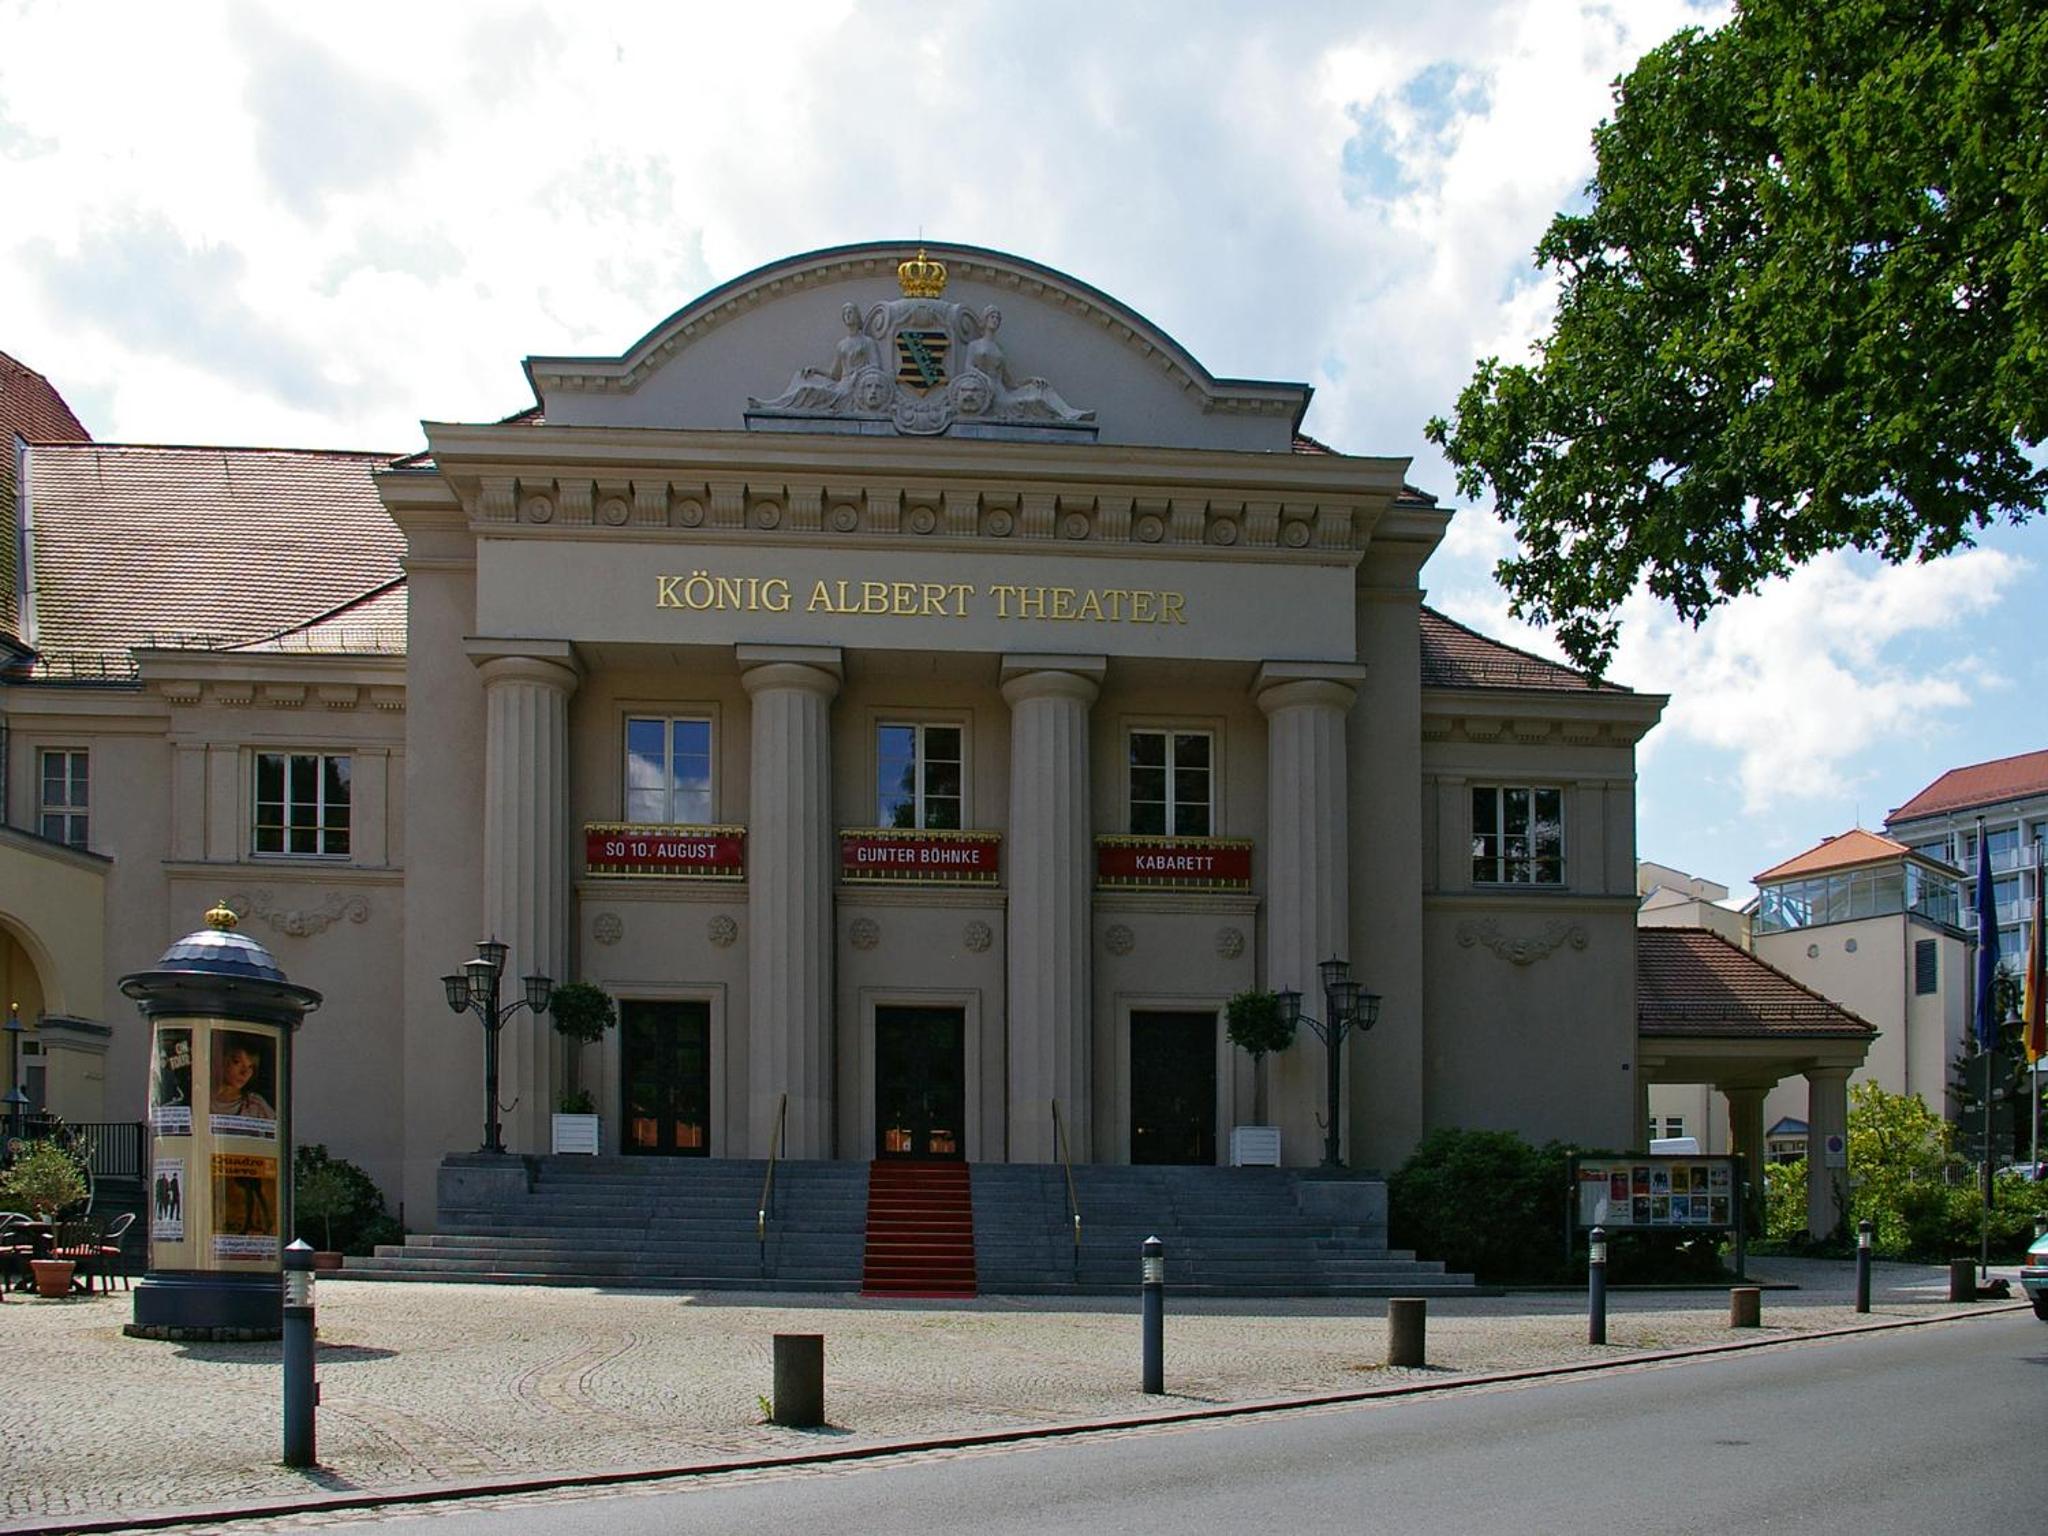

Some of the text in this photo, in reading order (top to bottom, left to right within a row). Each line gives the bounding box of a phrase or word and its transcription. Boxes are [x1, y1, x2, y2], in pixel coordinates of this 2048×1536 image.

[655, 570, 1188, 624] KÖNIG ALBERT THEATER
[606, 842, 717, 859] SO 10. AUGUST
[857, 847, 980, 864] GUNTER BÖHNKE
[1136, 856, 1214, 871] KABARETT
